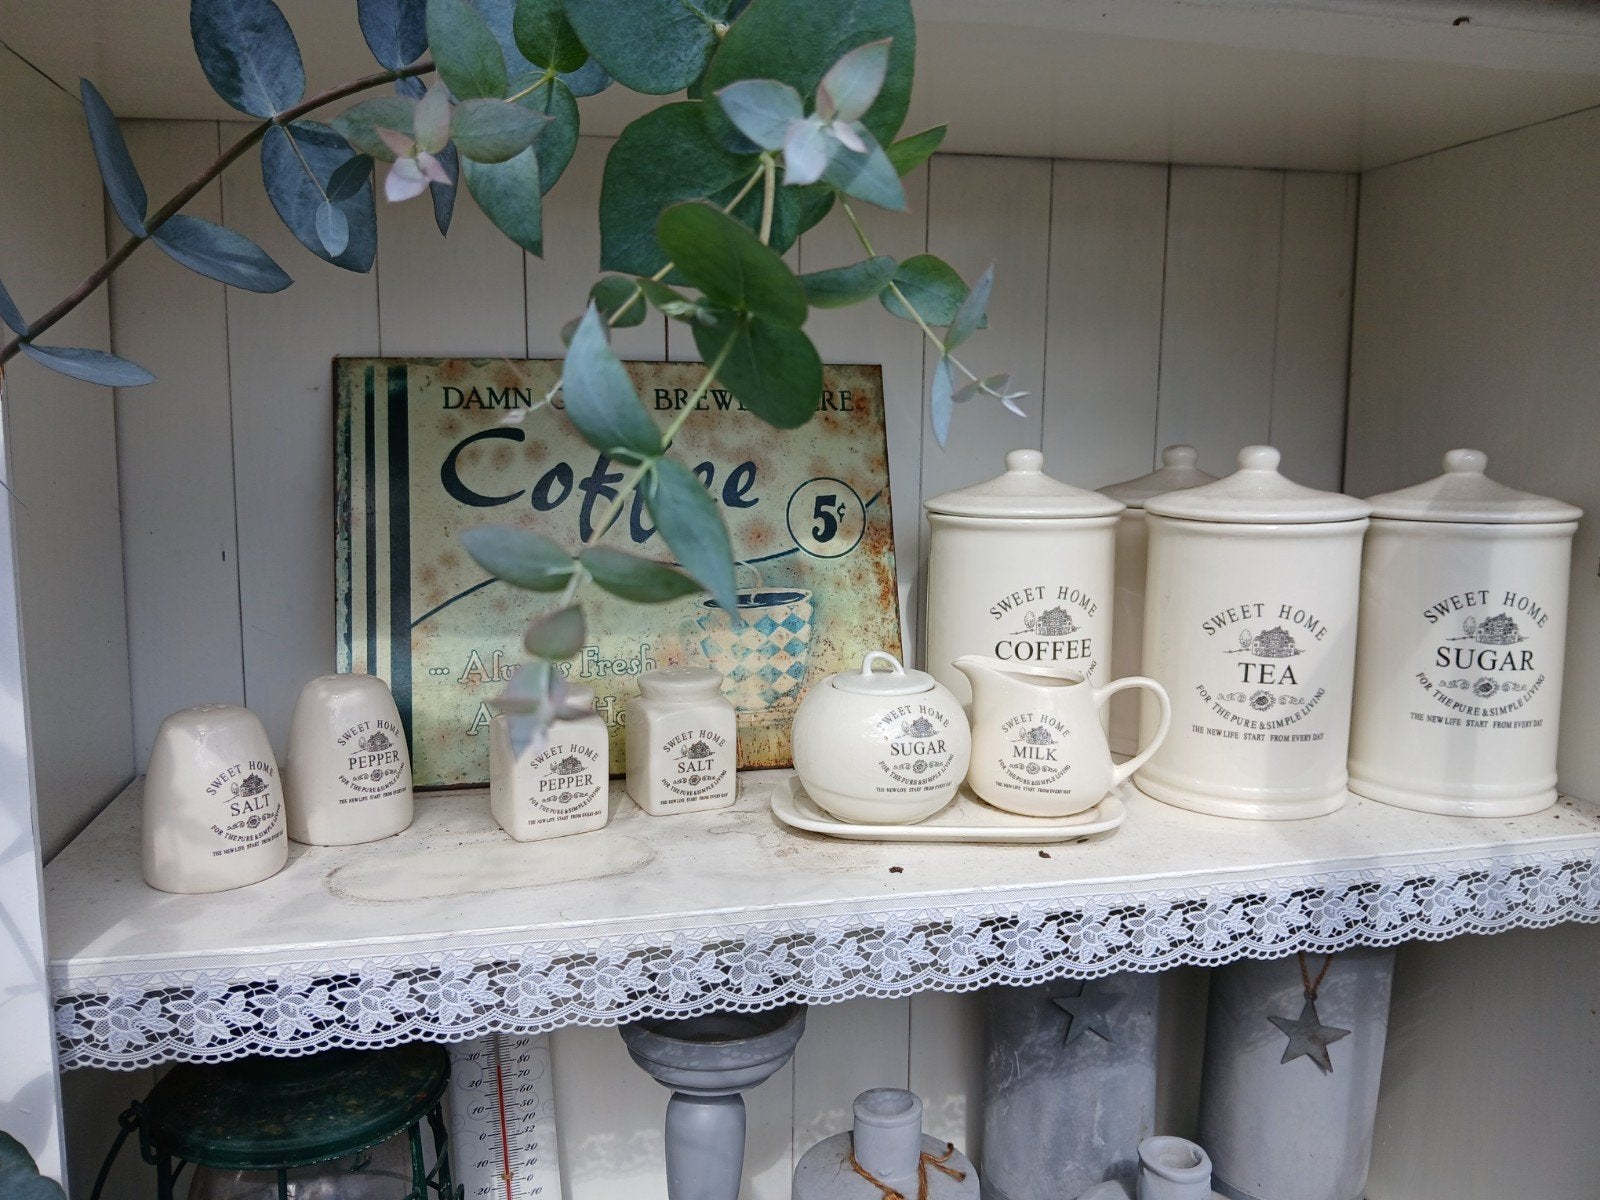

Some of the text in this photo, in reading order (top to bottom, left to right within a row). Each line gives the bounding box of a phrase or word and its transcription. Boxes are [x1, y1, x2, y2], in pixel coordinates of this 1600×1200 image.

[442, 386, 533, 409] DAMN
[654, 388, 750, 411] BREW
[990, 586, 1097, 620] SWEET HOME
[1424, 590, 1548, 628] SWEET HOME
[1202, 603, 1328, 641] SWEET HOME
[995, 638, 1092, 660] COFFEE
[1436, 646, 1534, 671] SUGAR
[457, 650, 572, 684] Als
[579, 643, 658, 678] Fresh
[1238, 662, 1298, 685] TEA
[1416, 672, 1432, 691] FOR
[1433, 689, 1454, 706] THE
[1452, 701, 1479, 716] PURE
[1490, 698, 1524, 716] SIMPLE
[1524, 674, 1545, 702] LIVING
[919, 705, 949, 727] HOME
[1196, 684, 1212, 703] FOR
[1212, 702, 1231, 719] THE
[1230, 714, 1256, 729] PURE
[1266, 712, 1301, 730] SIMPLE
[1302, 688, 1325, 716] LIVING
[1002, 713, 1070, 737] SWEET HOME
[1410, 712, 1424, 721] THE
[1445, 718, 1461, 726] LIFE
[338, 720, 400, 746] SWEET HOME
[663, 730, 726, 752] SWEET HOME
[1192, 725, 1204, 733] THE
[1224, 730, 1239, 738] LIFE
[1244, 733, 1265, 741] START
[1270, 734, 1289, 742] FROM
[531, 744, 599, 769] SWEET HOME
[891, 740, 947, 756] SUGAR
[1013, 746, 1058, 761] MILK
[348, 750, 400, 770] PEPPER
[678, 759, 714, 773] SALT
[879, 761, 890, 773] FOR
[890, 772, 902, 781] THE
[206, 761, 274, 795] SWEET HOME
[539, 774, 593, 792] PEPPER
[231, 794, 270, 817] SALT
[211, 825, 223, 835] FOR
[225, 833, 237, 841] THE
[515, 1038, 529, 1050] 90
[466, 1053, 480, 1061] 30
[468, 1079, 482, 1087] 20
[518, 1069, 530, 1077] 70
[520, 1084, 533, 1092] 60
[525, 1158, 537, 1166] 10
